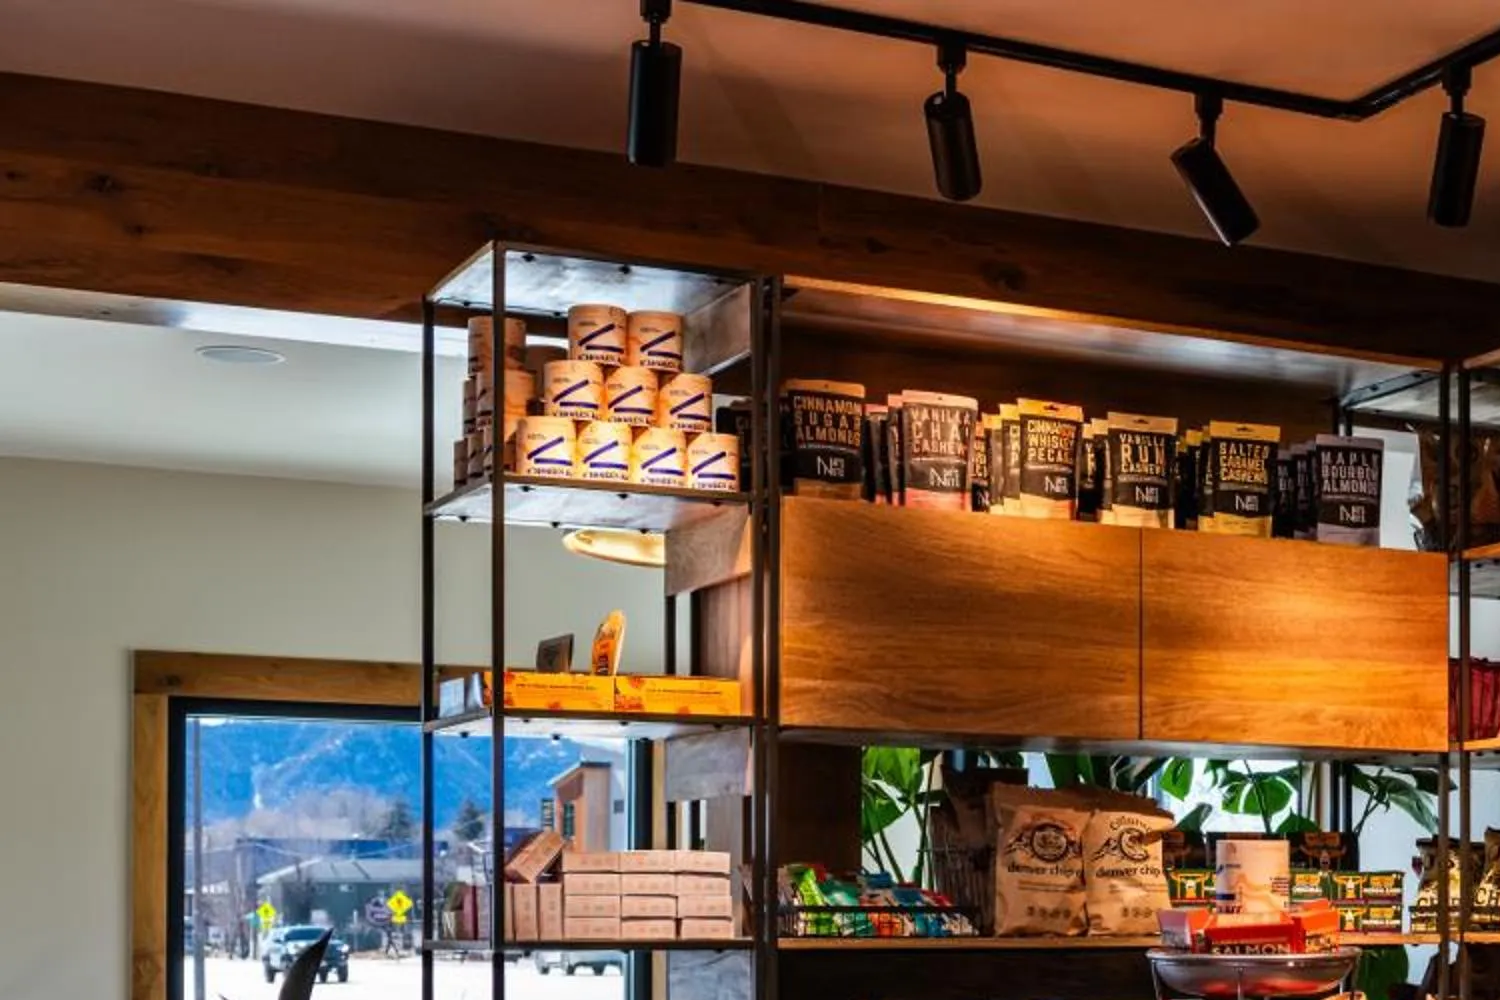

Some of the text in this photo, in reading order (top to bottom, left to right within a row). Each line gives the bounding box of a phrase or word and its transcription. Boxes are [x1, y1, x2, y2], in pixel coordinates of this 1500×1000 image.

[793, 395, 862, 417] CINNAMON
[1027, 419, 1072, 436] CINNA
[1008, 861, 1045, 874] denver
[1050, 863, 1073, 878] chip
[1096, 864, 1161, 878] denver chip
